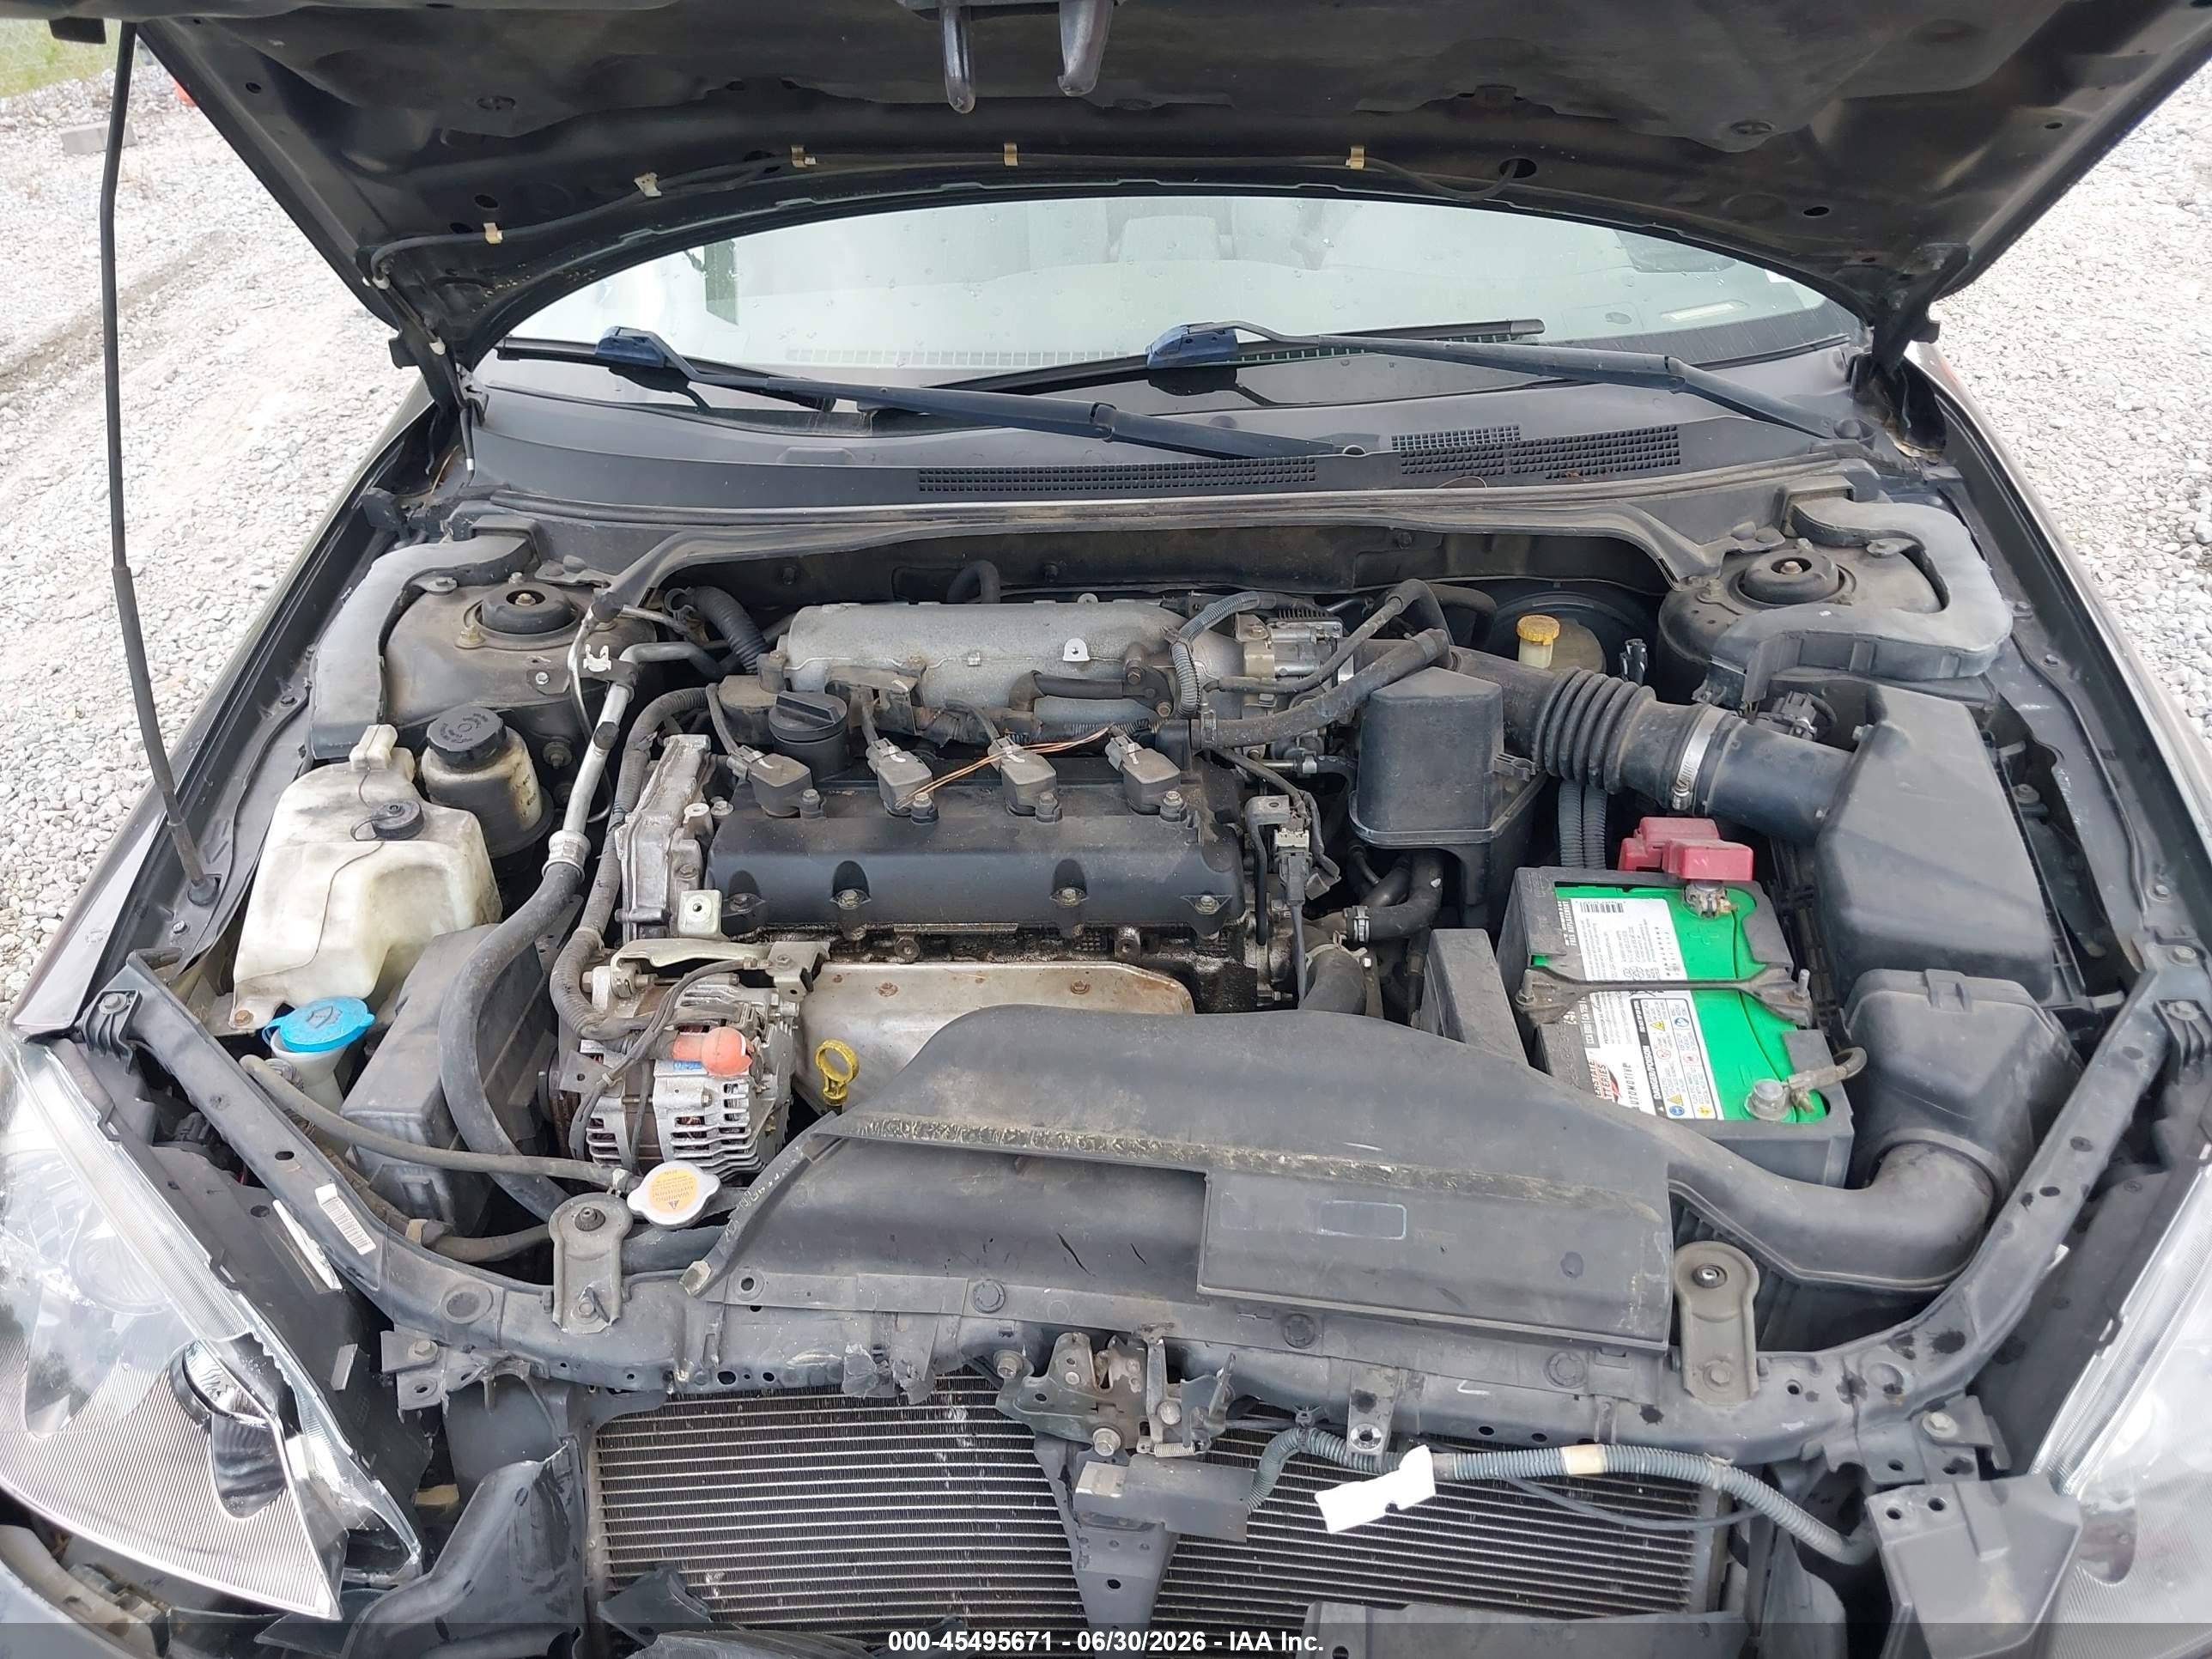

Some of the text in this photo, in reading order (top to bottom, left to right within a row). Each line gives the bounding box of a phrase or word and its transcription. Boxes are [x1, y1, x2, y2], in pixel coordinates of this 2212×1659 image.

[1562, 901, 1574, 932] REPLACEMENT
[1588, 1060, 1601, 1097] ERSTATE
[1597, 1064, 1612, 1097] TTERIES
[1622, 1062, 1639, 1109] UTOMOTIVE
[1642, 1045, 1661, 1099] DANGER/POISON
